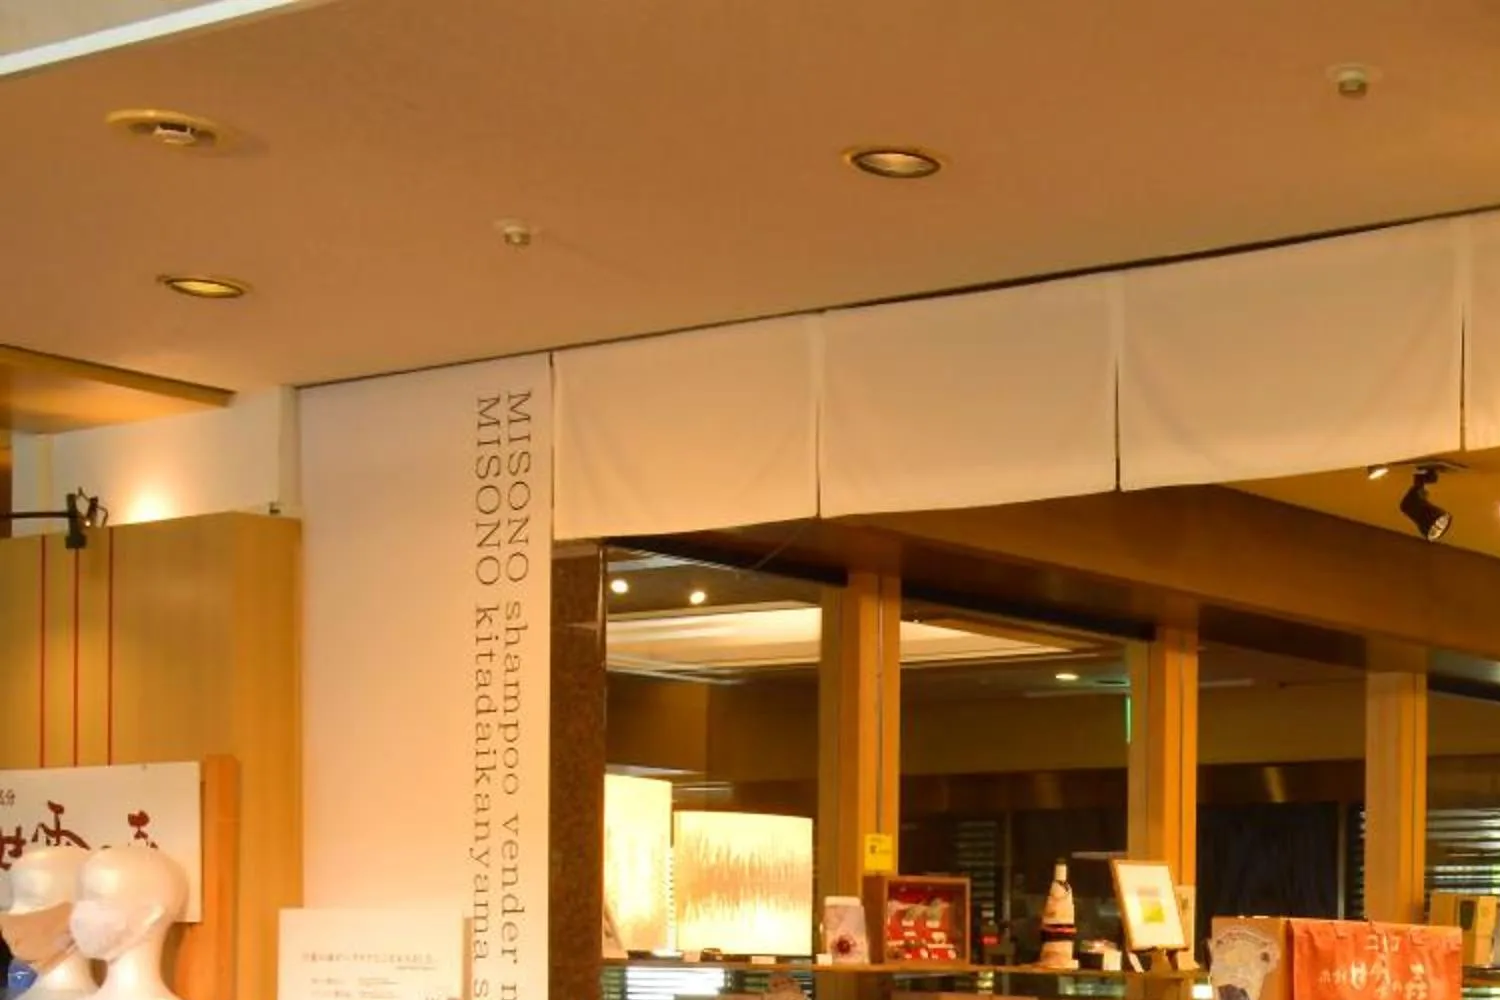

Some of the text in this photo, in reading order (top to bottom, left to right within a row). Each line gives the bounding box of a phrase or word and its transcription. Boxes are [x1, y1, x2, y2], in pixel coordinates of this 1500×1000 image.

[475, 396, 501, 587] MISONO
[506, 390, 532, 583] MISONO
[469, 604, 500, 961] kitadaikanyama
[499, 600, 529, 796] shampoo
[501, 813, 526, 965] vender
